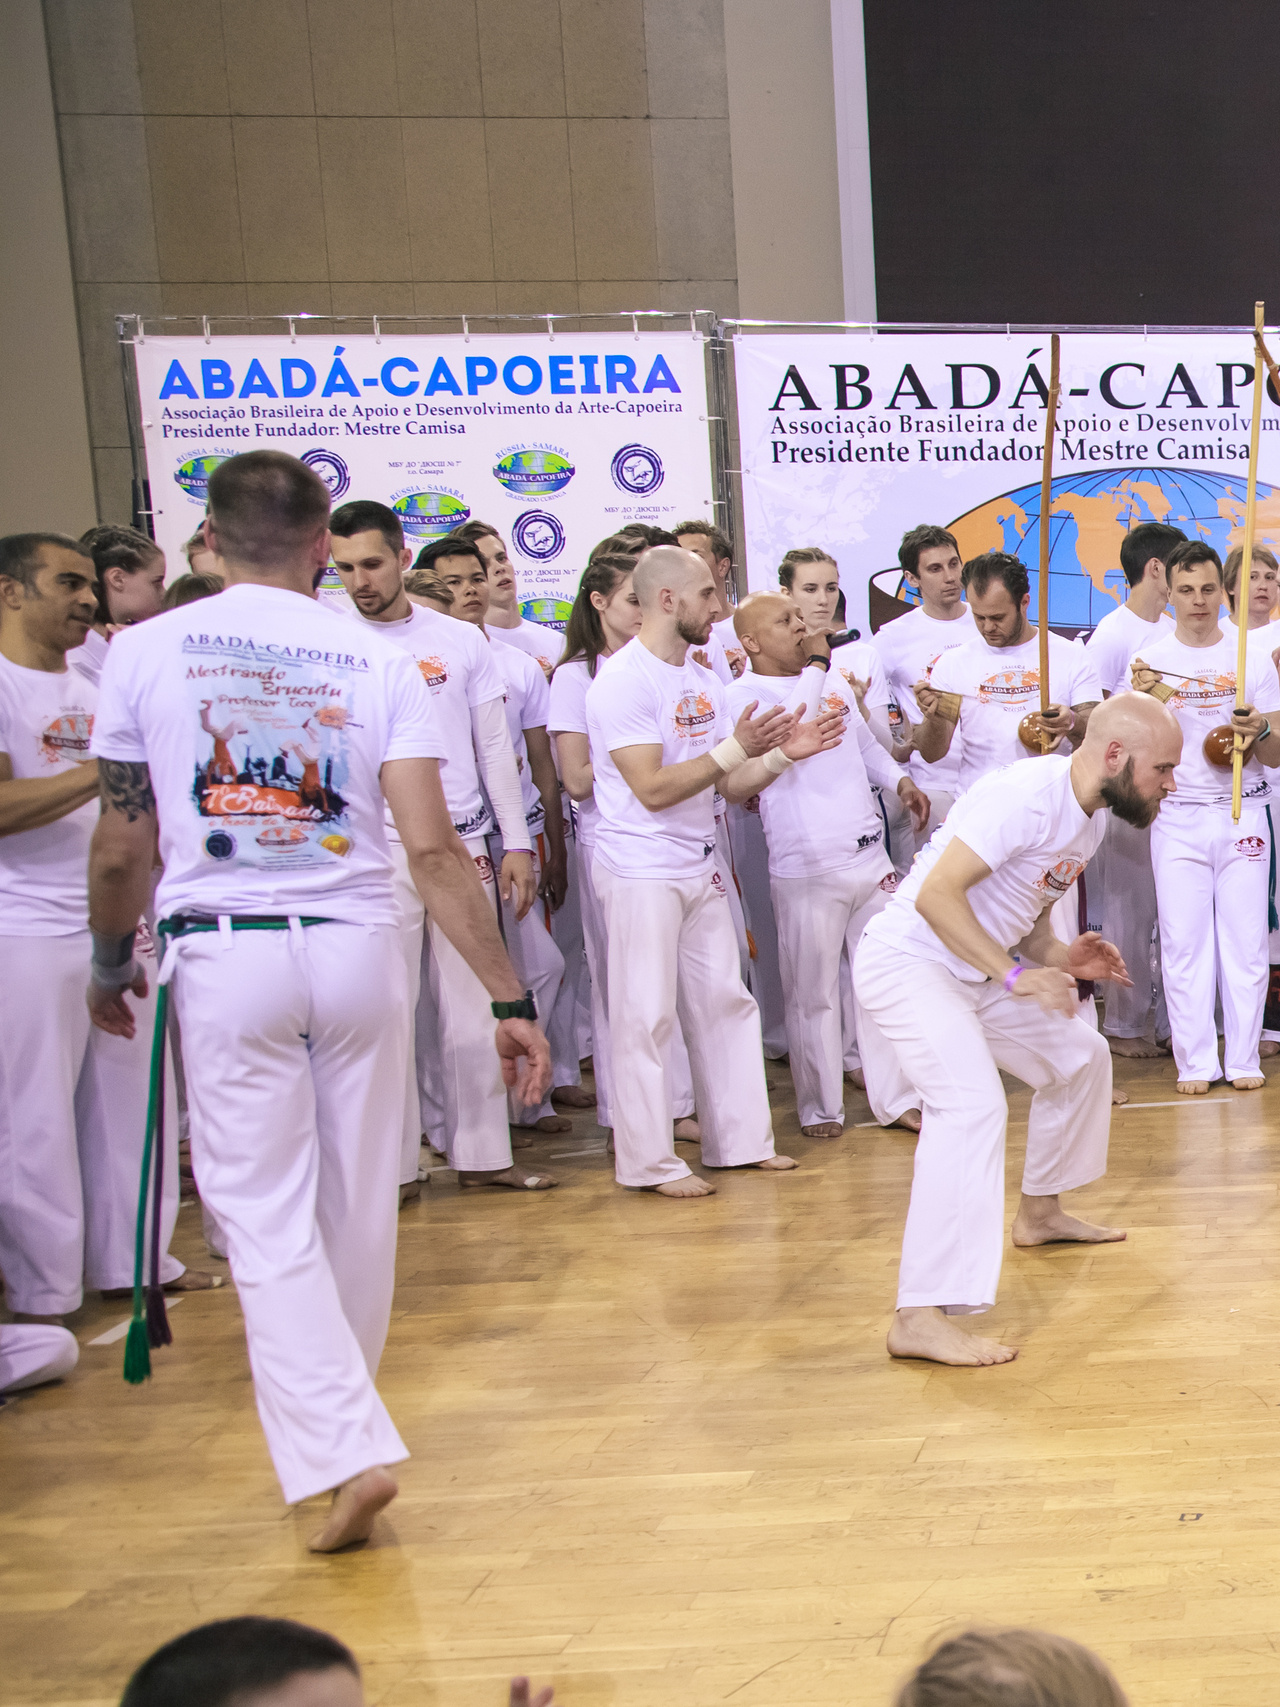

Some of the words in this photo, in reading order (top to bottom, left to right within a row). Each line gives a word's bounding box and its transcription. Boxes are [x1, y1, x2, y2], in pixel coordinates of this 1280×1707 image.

[159, 345, 682, 400] ABADÁ-CAPOEIRA
[161, 406, 246, 423] Associação
[251, 404, 324, 419] Brasileira
[329, 403, 347, 418] de
[352, 402, 399, 421] Apoio
[403, 406, 412, 417] e
[416, 402, 550, 417] Desenvolvimento
[555, 401, 573, 415] da
[578, 400, 683, 417] Arte-Capoeira
[162, 424, 250, 439] Presidente
[255, 422, 339, 437] Fundador:
[345, 422, 400, 437] Mestre
[405, 420, 466, 435] Camisa
[771, 415, 892, 438] Associação
[899, 413, 1005, 433] Brasileira
[1013, 413, 1038, 432] de
[1118, 418, 1130, 432] e
[532, 441, 570, 459] SAMARA
[771, 439, 910, 463] Presidente
[1060, 438, 1148, 461] Mestre
[1156, 436, 1251, 461] Camisa
[427, 484, 465, 501] SAMARA
[517, 591, 537, 601] SSIA
[543, 590, 576, 602] SAMAR
